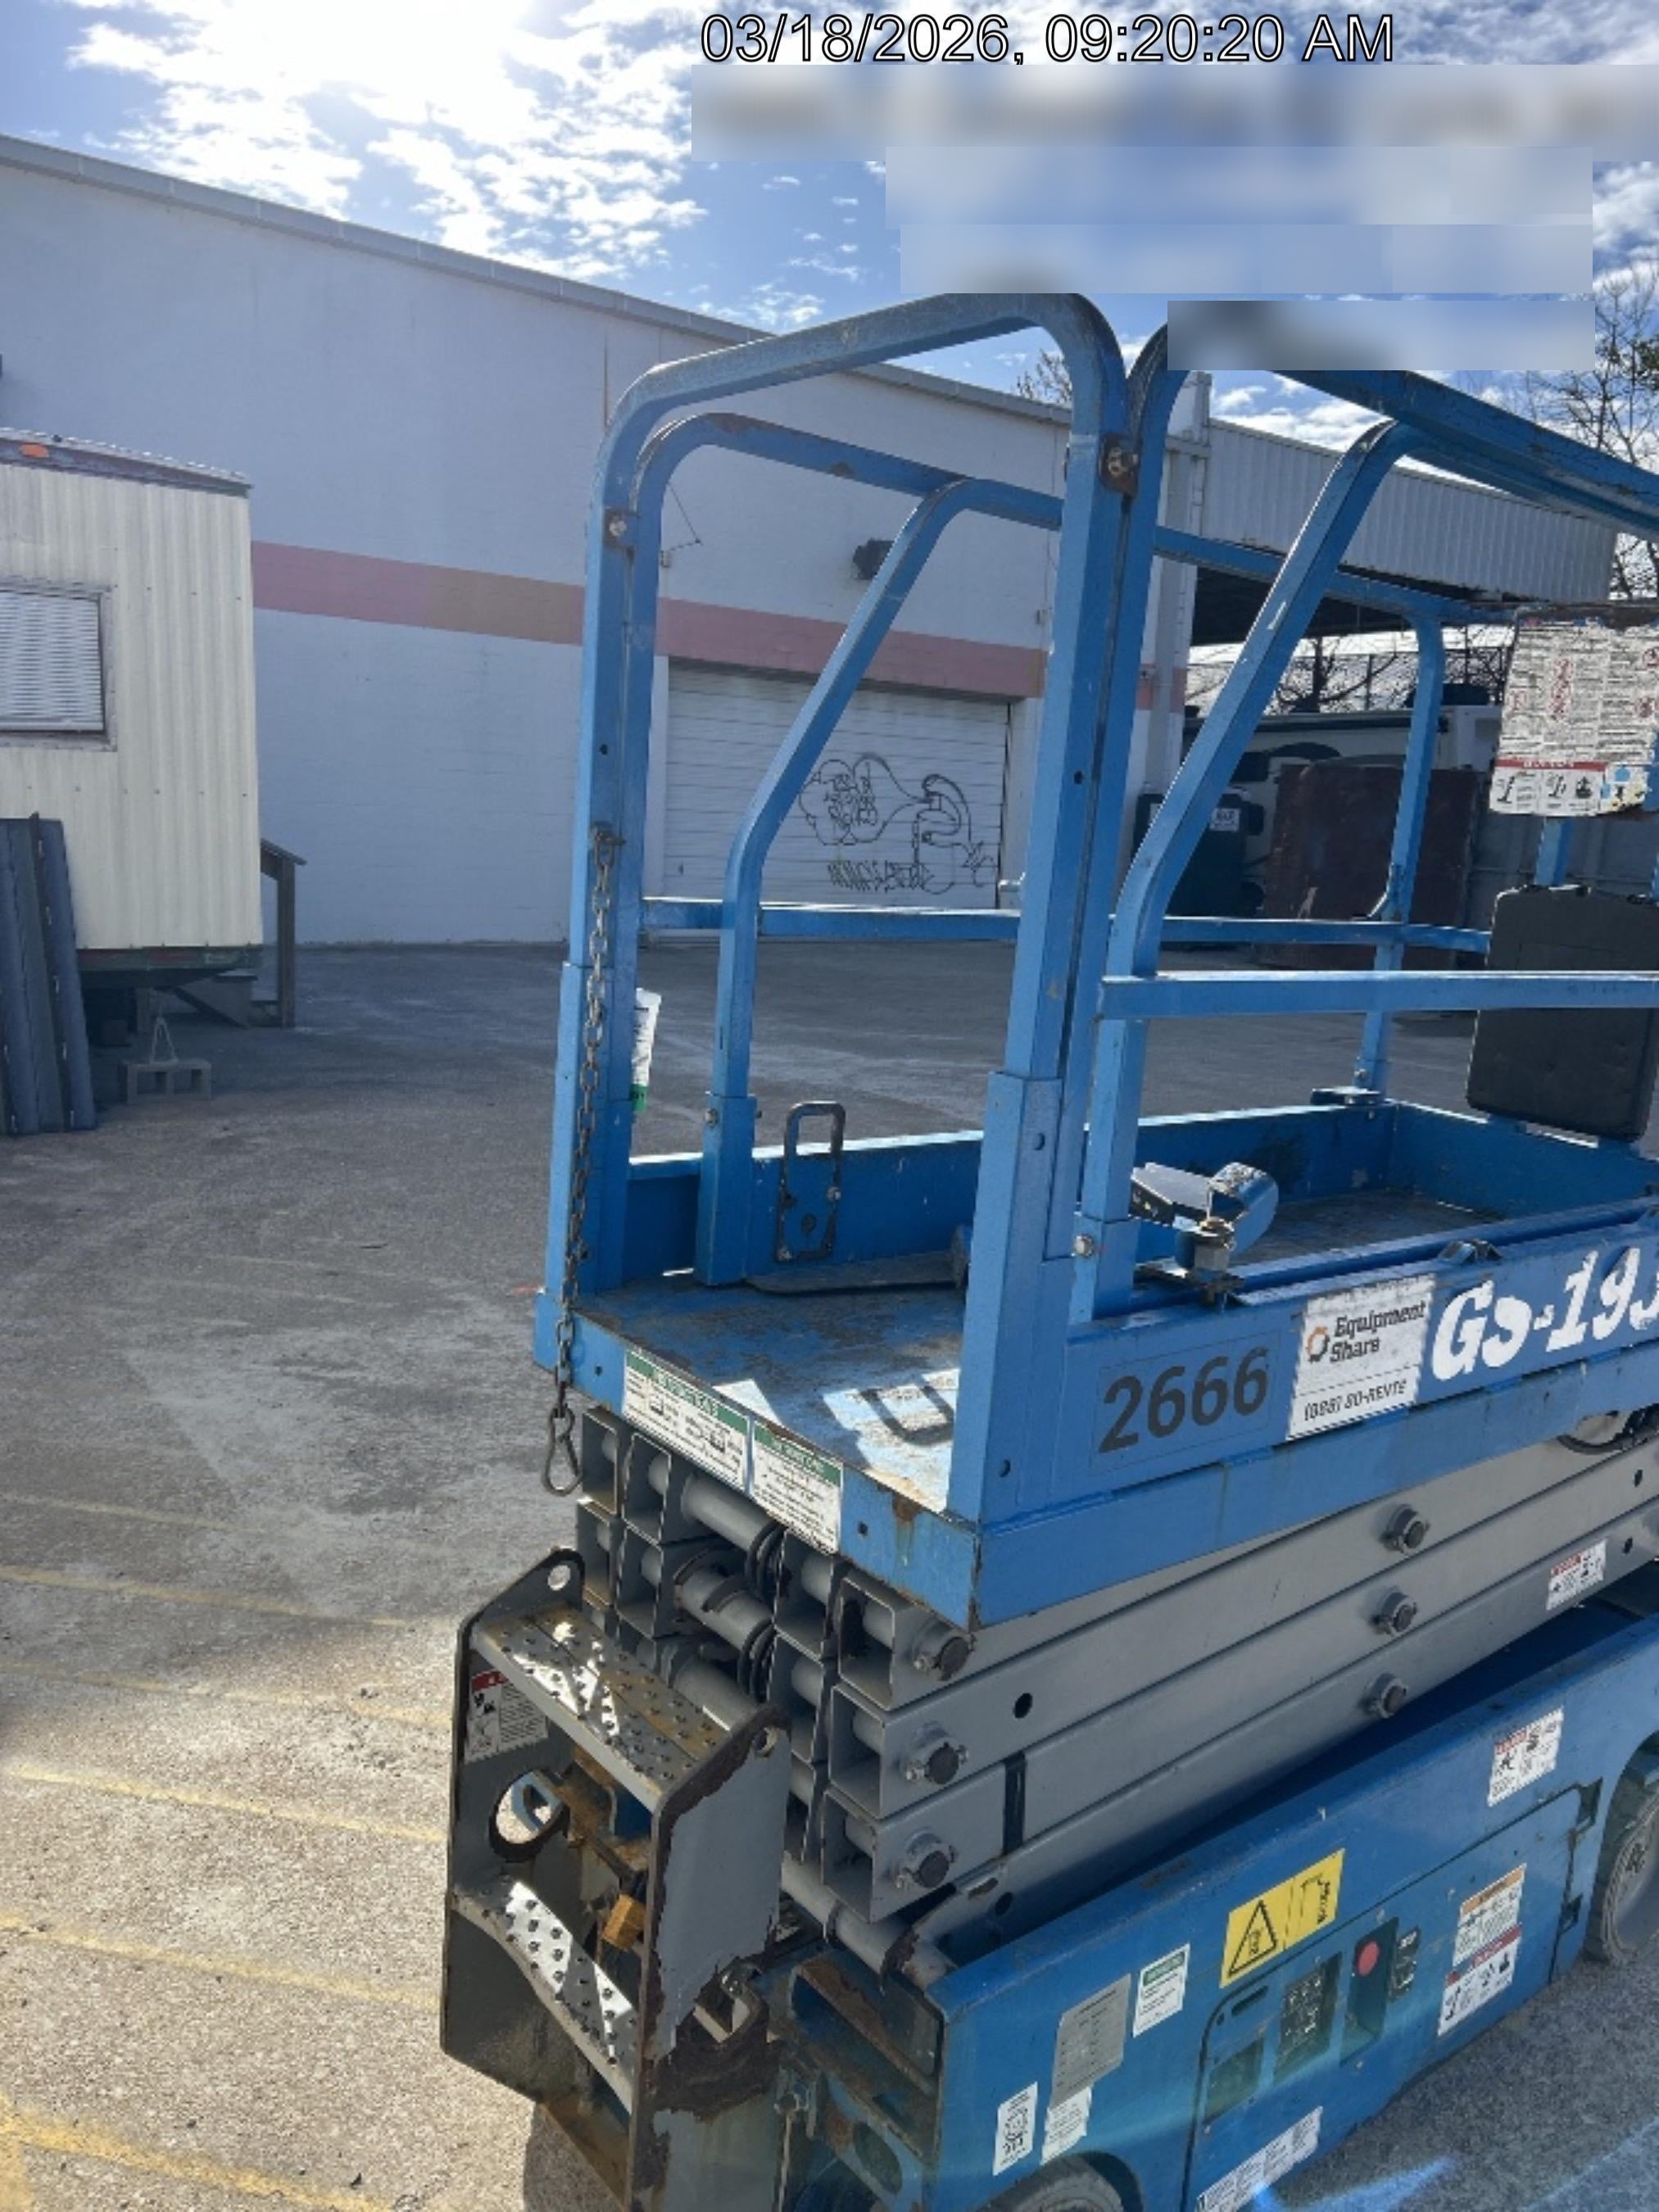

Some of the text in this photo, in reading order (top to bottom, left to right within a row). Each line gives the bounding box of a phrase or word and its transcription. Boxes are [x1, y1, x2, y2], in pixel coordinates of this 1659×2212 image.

[1335, 1300, 1426, 1339] Equipment
[1330, 1338, 1380, 1363] Share
[1098, 1346, 1270, 1453] 2666
